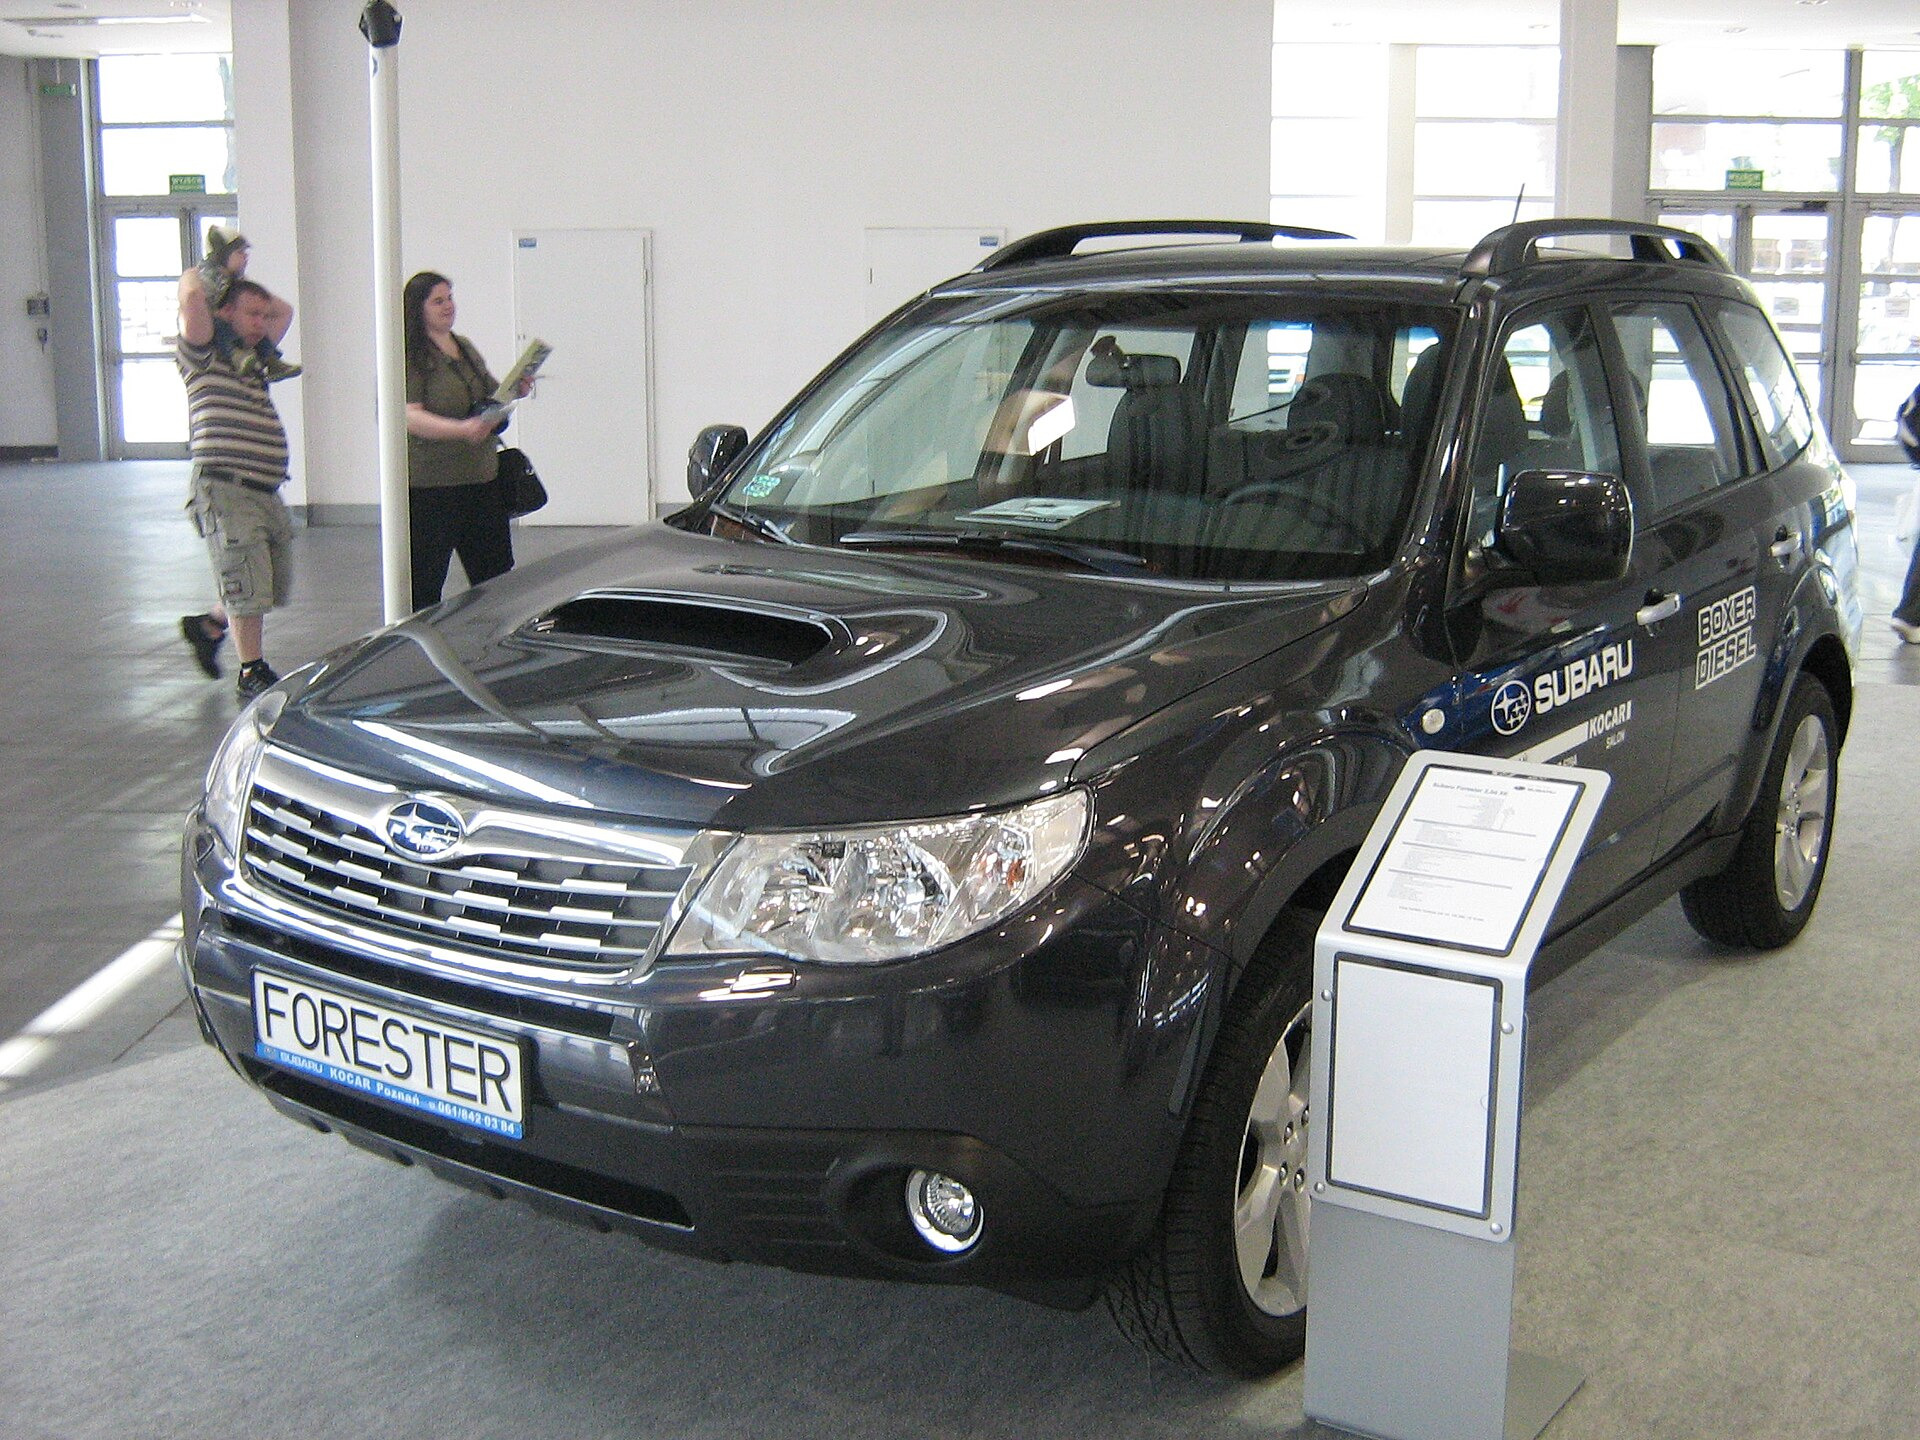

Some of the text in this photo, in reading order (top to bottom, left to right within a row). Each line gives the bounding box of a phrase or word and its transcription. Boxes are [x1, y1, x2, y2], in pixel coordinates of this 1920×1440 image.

[1697, 585, 1756, 647] BOXER
[1533, 639, 1633, 715] SUBARU
[1695, 626, 1757, 690] DIESEL
[1589, 701, 1627, 739] KOCAR
[262, 981, 513, 1113] FORESTER
[280, 1052, 323, 1074] SUBARU
[330, 1067, 371, 1090] KOCAR
[376, 1082, 420, 1106] Poznań
